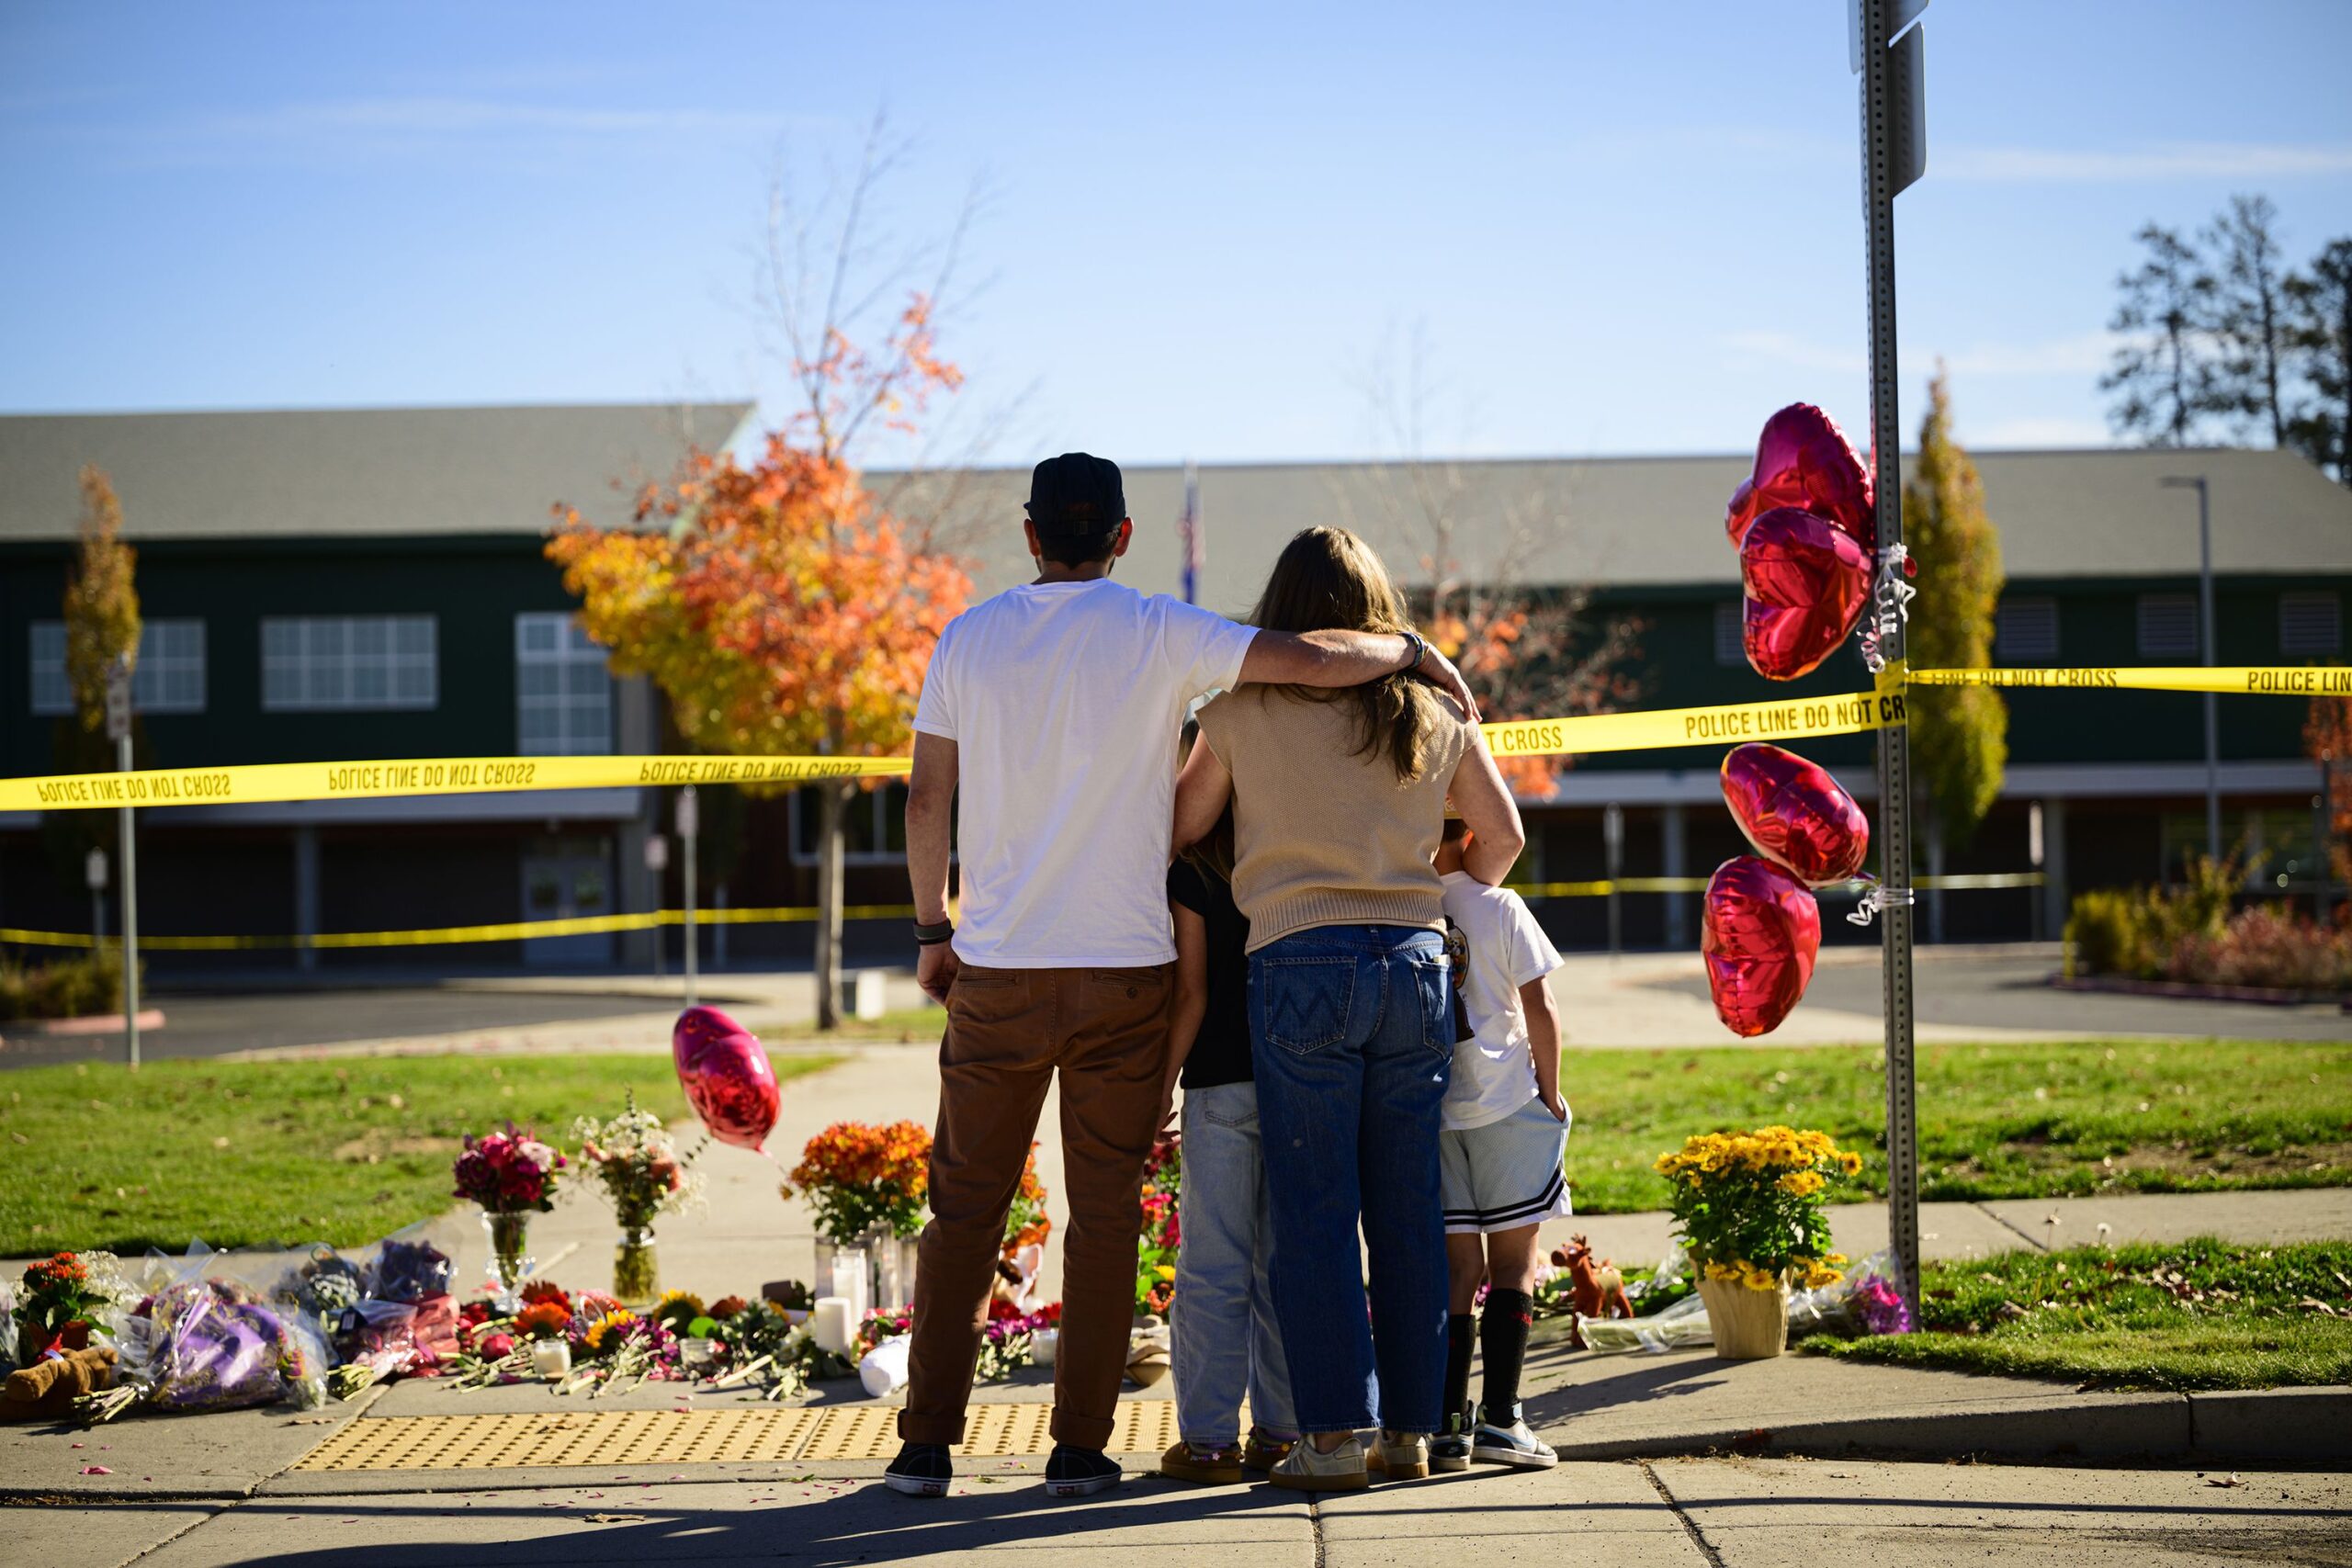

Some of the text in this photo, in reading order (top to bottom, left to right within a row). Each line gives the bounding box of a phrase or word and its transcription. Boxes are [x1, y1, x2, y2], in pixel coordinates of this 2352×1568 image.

[2012, 671, 2047, 686] NOT
[2054, 670, 2117, 687] CROSS
[2247, 671, 2352, 691] POLICE LIN
[1685, 712, 1751, 739] POLICE
[1758, 708, 1798, 732] LINE
[1805, 705, 1829, 728] DO
[1838, 699, 1872, 726] NOT
[1503, 726, 1563, 750] CROSS
